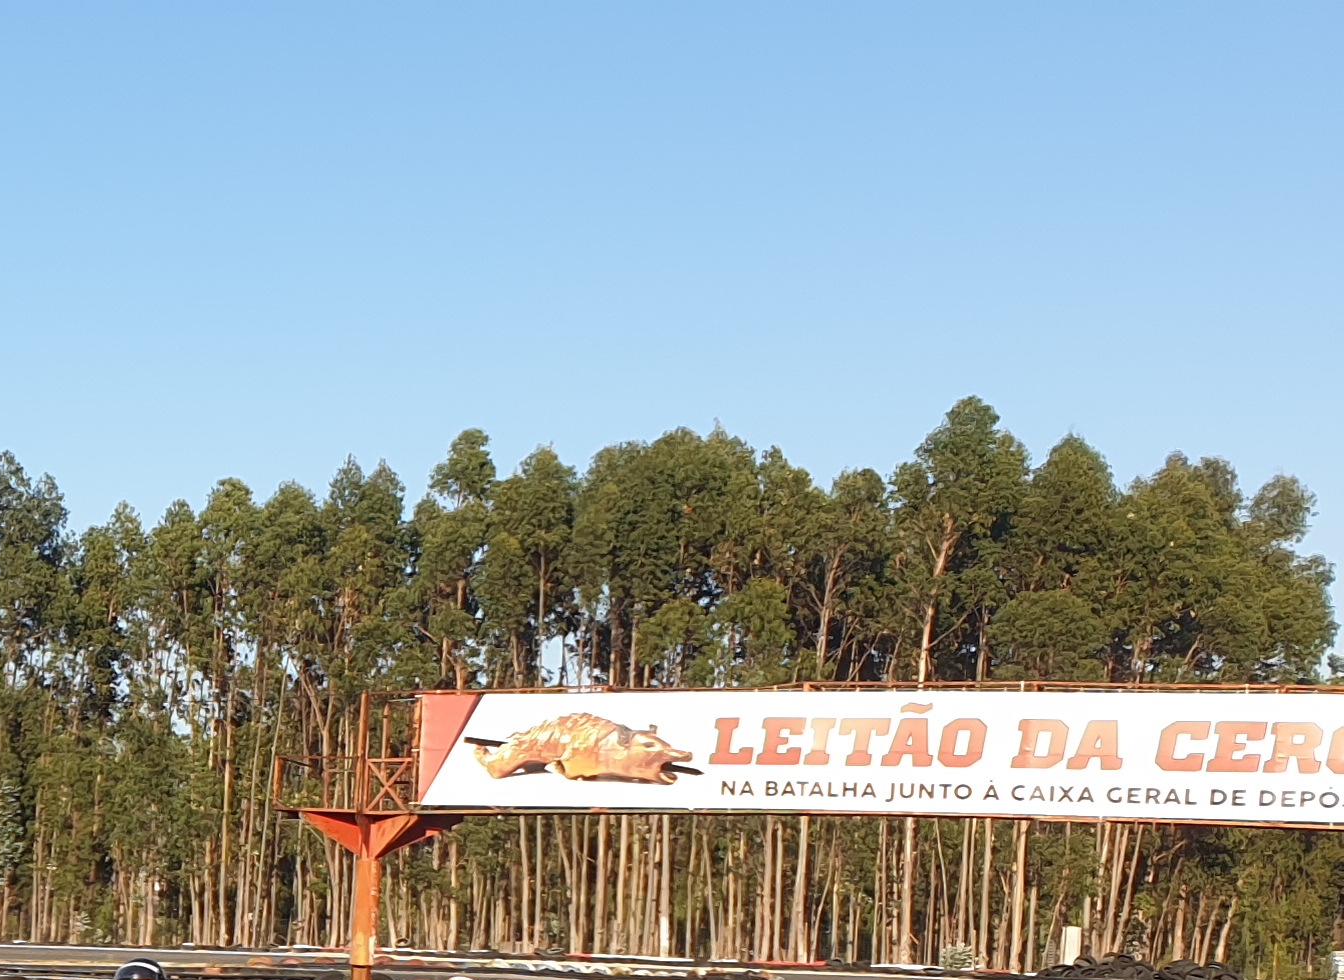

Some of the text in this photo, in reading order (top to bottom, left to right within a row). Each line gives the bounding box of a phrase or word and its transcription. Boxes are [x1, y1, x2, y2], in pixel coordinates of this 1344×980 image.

[708, 702, 988, 768] LEITÃO
[1010, 718, 1124, 771] DA
[720, 779, 1344, 809] NA BATALHA JUNTO À CAIXA GERAL DE DEPÓ
